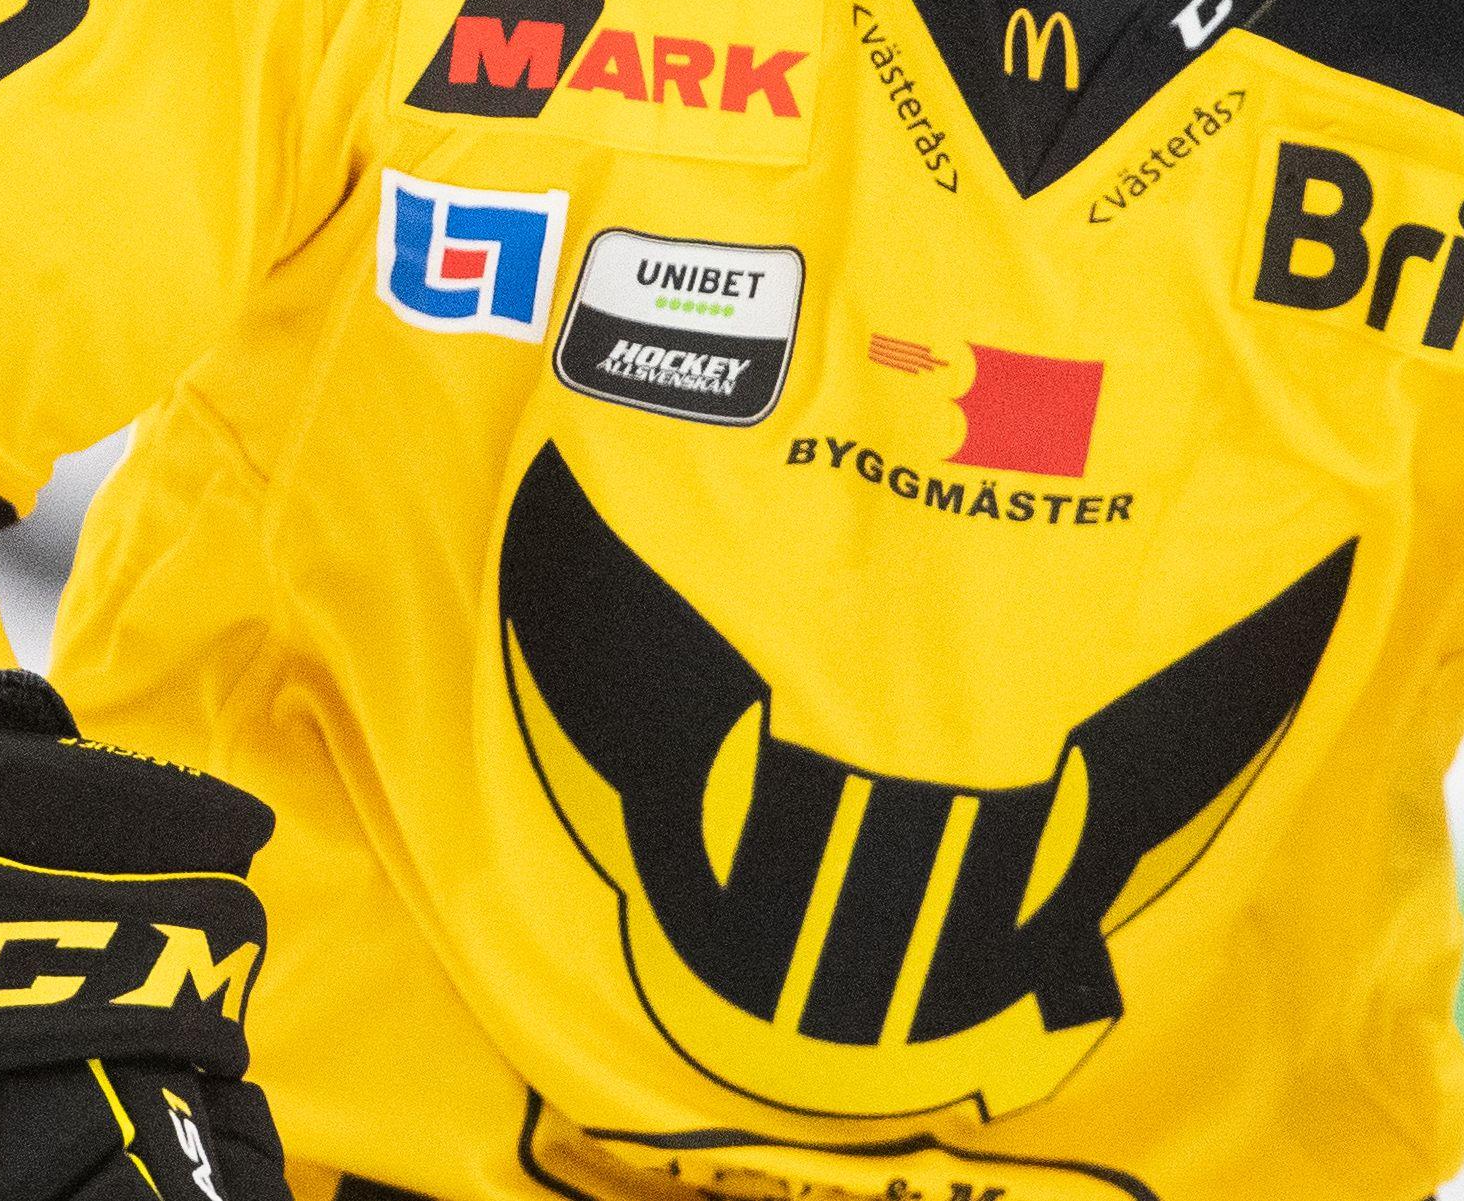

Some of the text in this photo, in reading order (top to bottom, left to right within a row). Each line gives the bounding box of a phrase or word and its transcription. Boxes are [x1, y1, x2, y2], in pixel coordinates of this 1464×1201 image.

[448, 15, 811, 119] MARK
[636, 258, 766, 300] UNIBET
[596, 359, 737, 396] ALLSVENSKAN
[608, 339, 752, 383] HOCKEY
[785, 435, 1136, 526] BYGGMÄSTER
